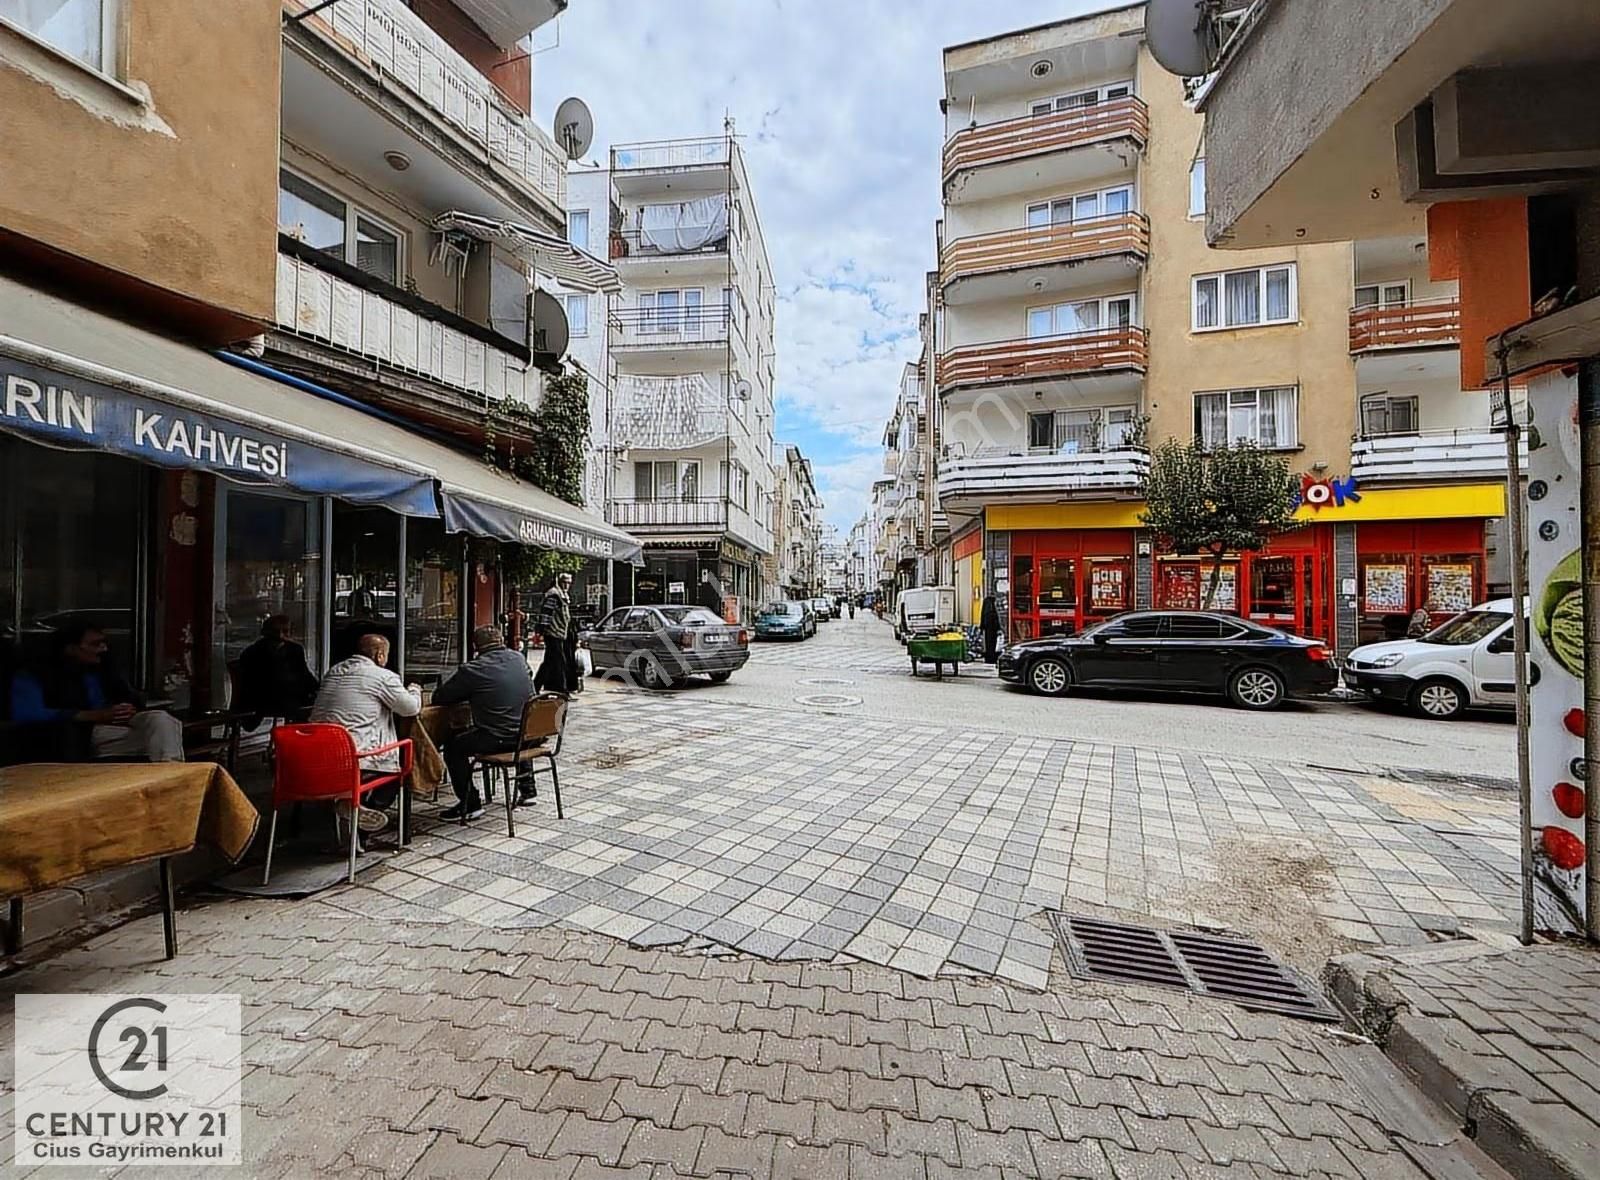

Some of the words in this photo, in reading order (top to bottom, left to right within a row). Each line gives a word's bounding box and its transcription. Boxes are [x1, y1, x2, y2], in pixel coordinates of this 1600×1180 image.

[0, 374, 93, 434] RIN
[135, 408, 287, 478] KAHVESİ
[1291, 475, 1361, 514] OK
[519, 519, 583, 551] ARNAVUTLARIN
